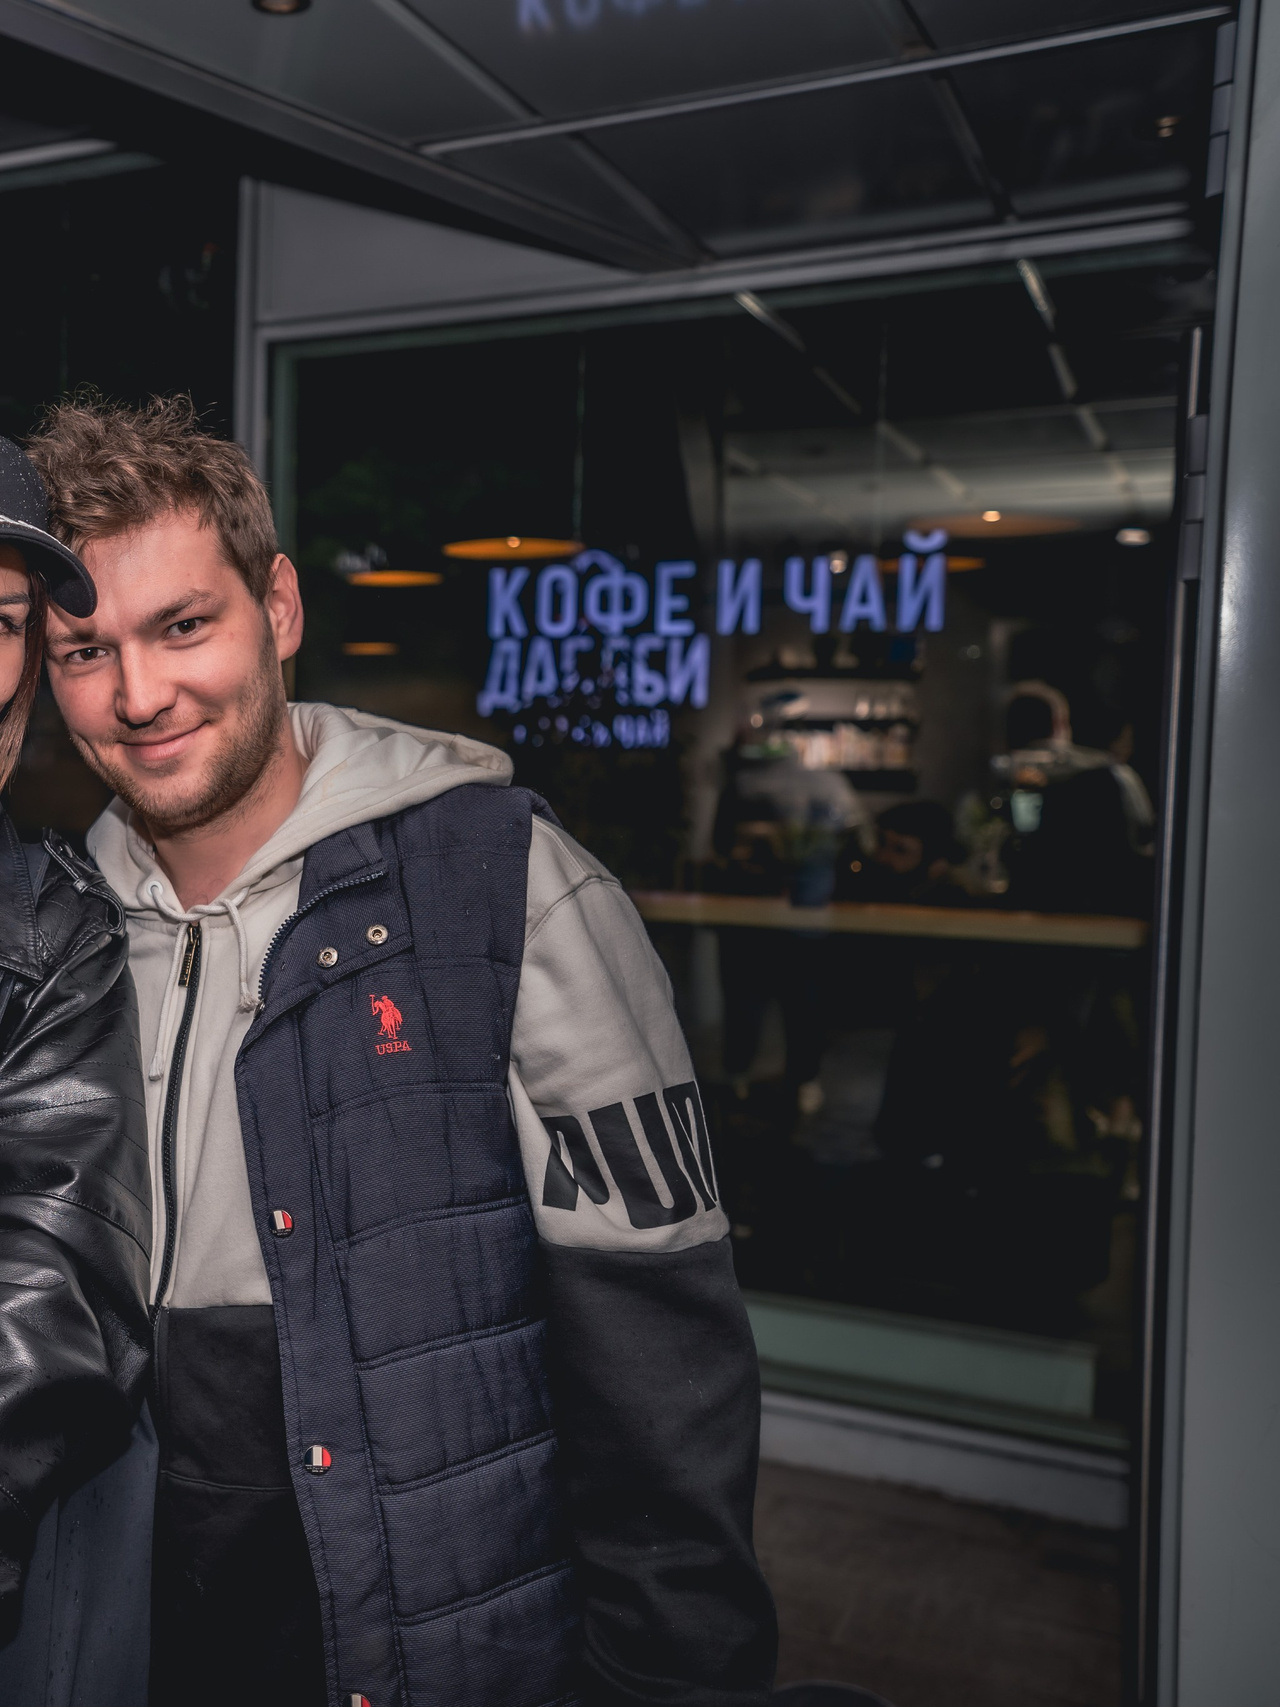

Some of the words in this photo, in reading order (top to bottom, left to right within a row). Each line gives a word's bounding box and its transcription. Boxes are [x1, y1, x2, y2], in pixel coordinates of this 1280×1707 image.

[487, 561, 698, 639] КОФЕ
[717, 557, 762, 636] И
[783, 529, 947, 635] ЧАЙ
[375, 1040, 412, 1056] USPA
